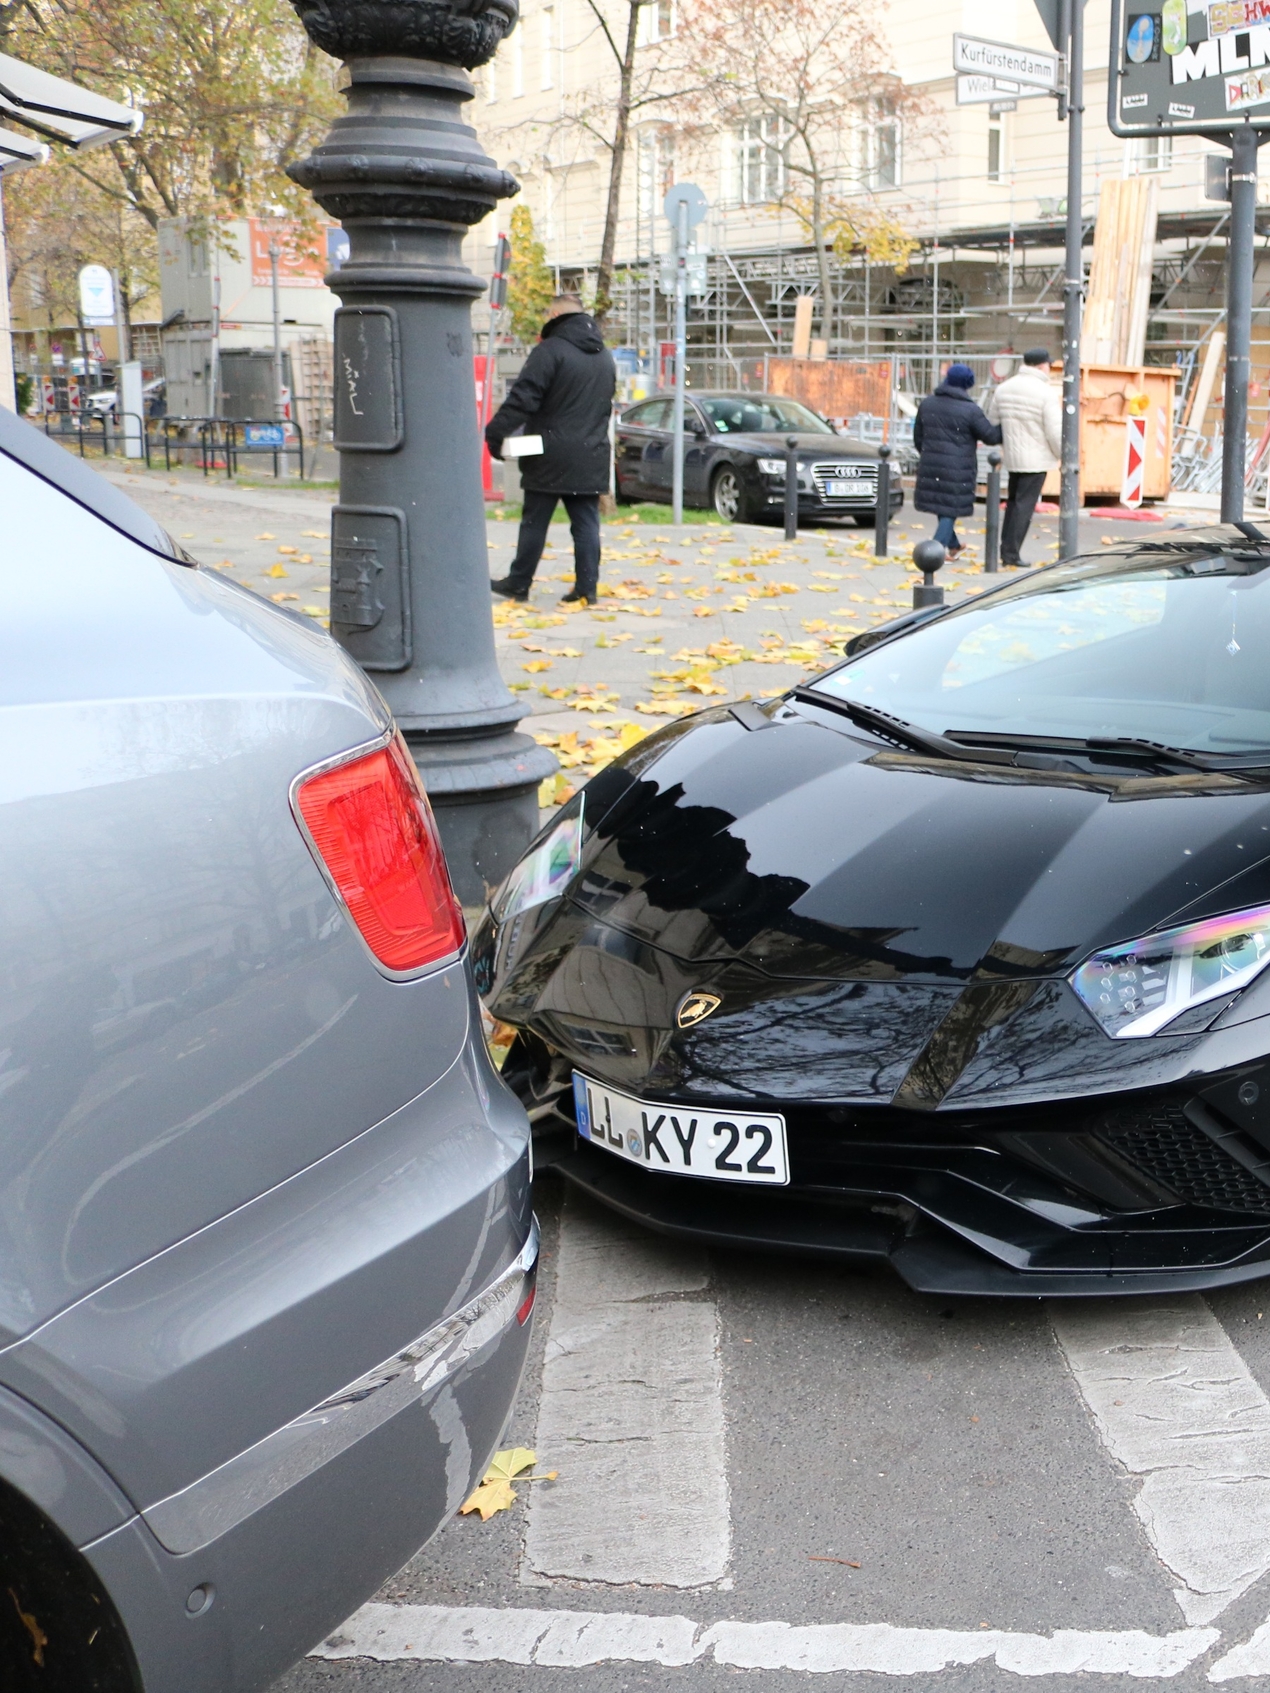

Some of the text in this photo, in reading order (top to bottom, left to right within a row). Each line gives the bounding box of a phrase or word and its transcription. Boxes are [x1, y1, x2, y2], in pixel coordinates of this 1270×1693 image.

[961, 42, 1053, 78] Kurfürstendamm
[586, 1086, 776, 1175] LL KY 22
